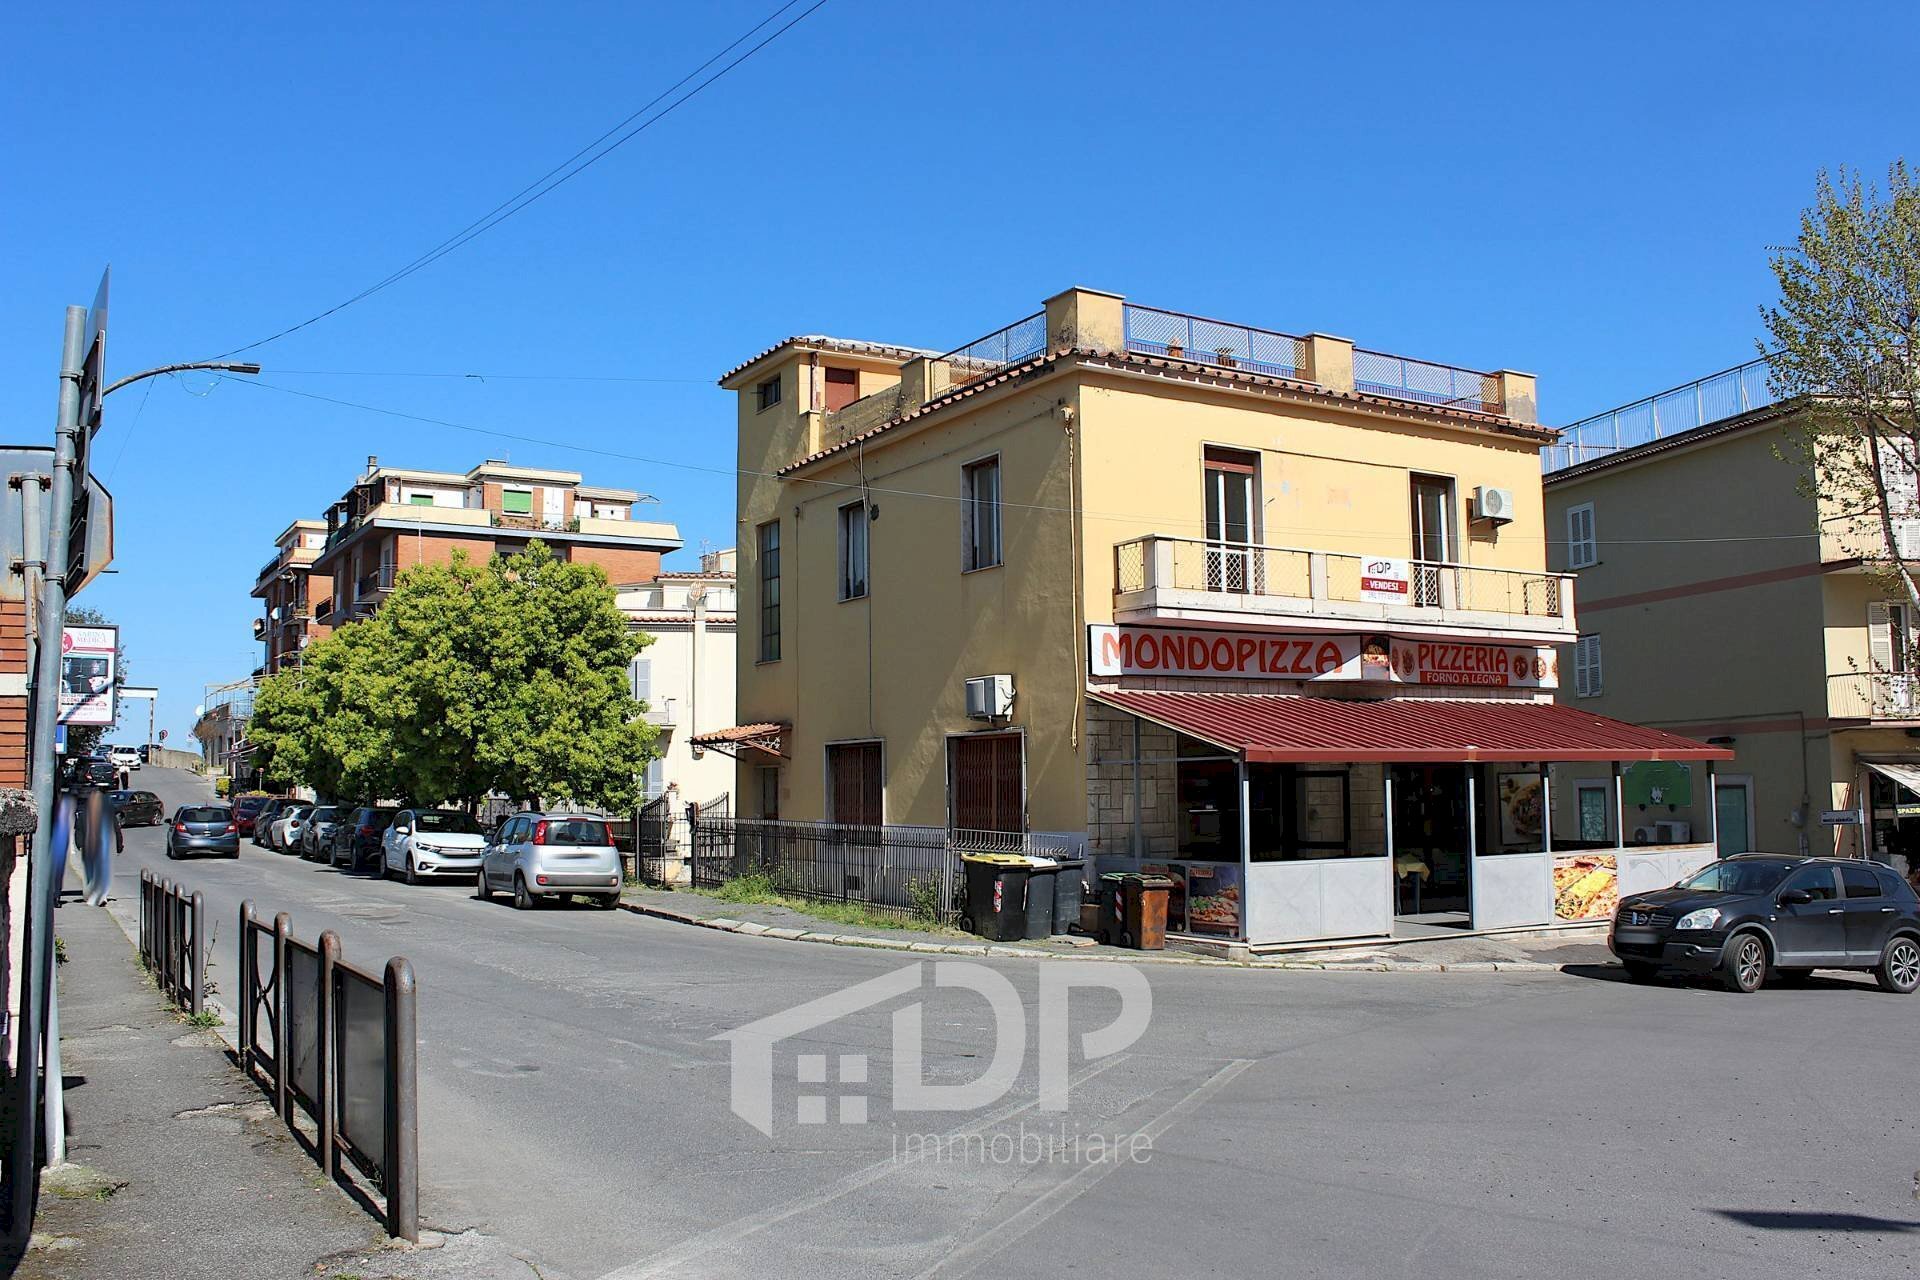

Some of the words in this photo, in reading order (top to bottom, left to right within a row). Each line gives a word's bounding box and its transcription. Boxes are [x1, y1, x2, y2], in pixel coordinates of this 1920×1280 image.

[1369, 580, 1399, 591] VENDESI
[1103, 632, 1343, 674] MONDOPIZZA
[1418, 643, 1509, 673] PIZZERIA
[1427, 673, 1460, 683] FORNO
[1462, 674, 1470, 683] A
[1471, 674, 1503, 684] LEGNA
